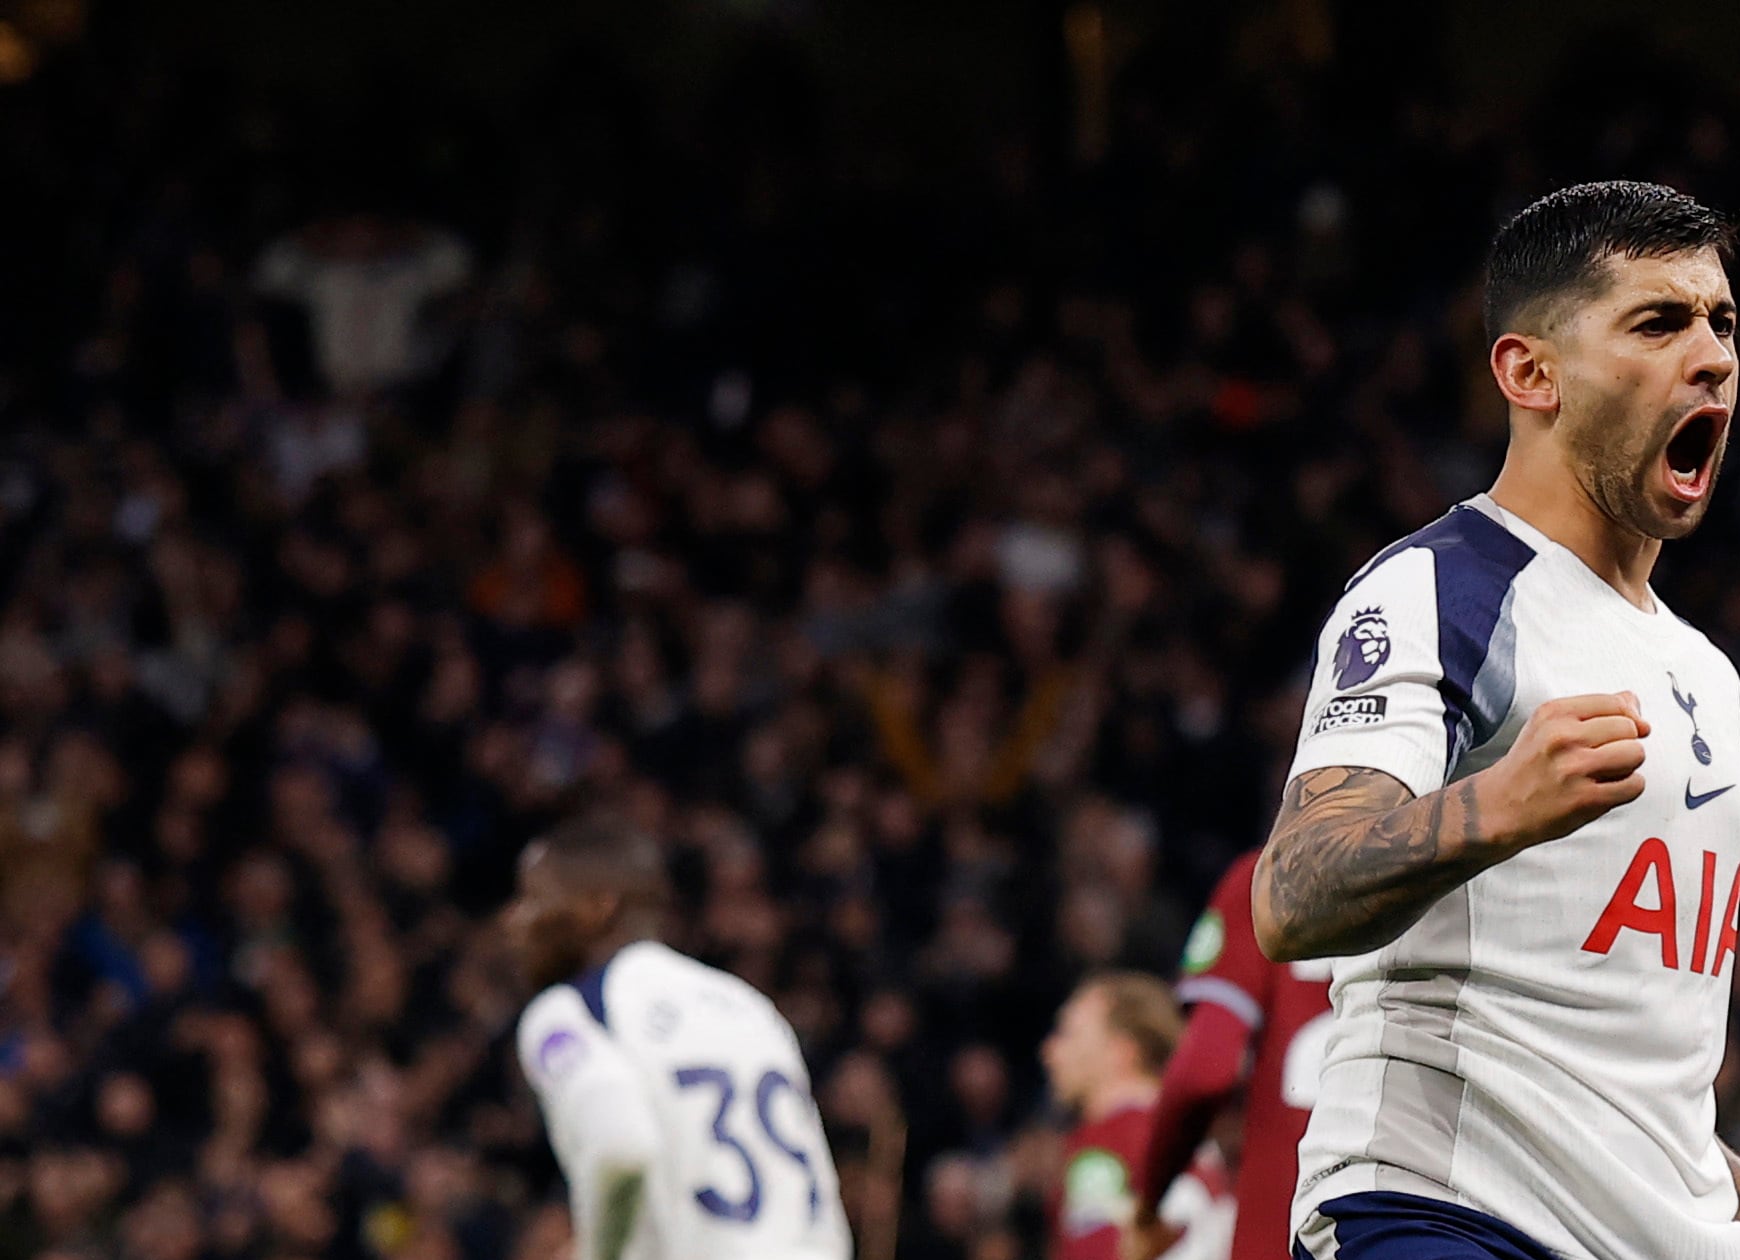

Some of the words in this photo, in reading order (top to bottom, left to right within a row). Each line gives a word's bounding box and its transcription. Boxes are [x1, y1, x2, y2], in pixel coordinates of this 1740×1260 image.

[1323, 697, 1377, 718] room
[1319, 712, 1384, 732] racism
[674, 1063, 822, 1224] 39
